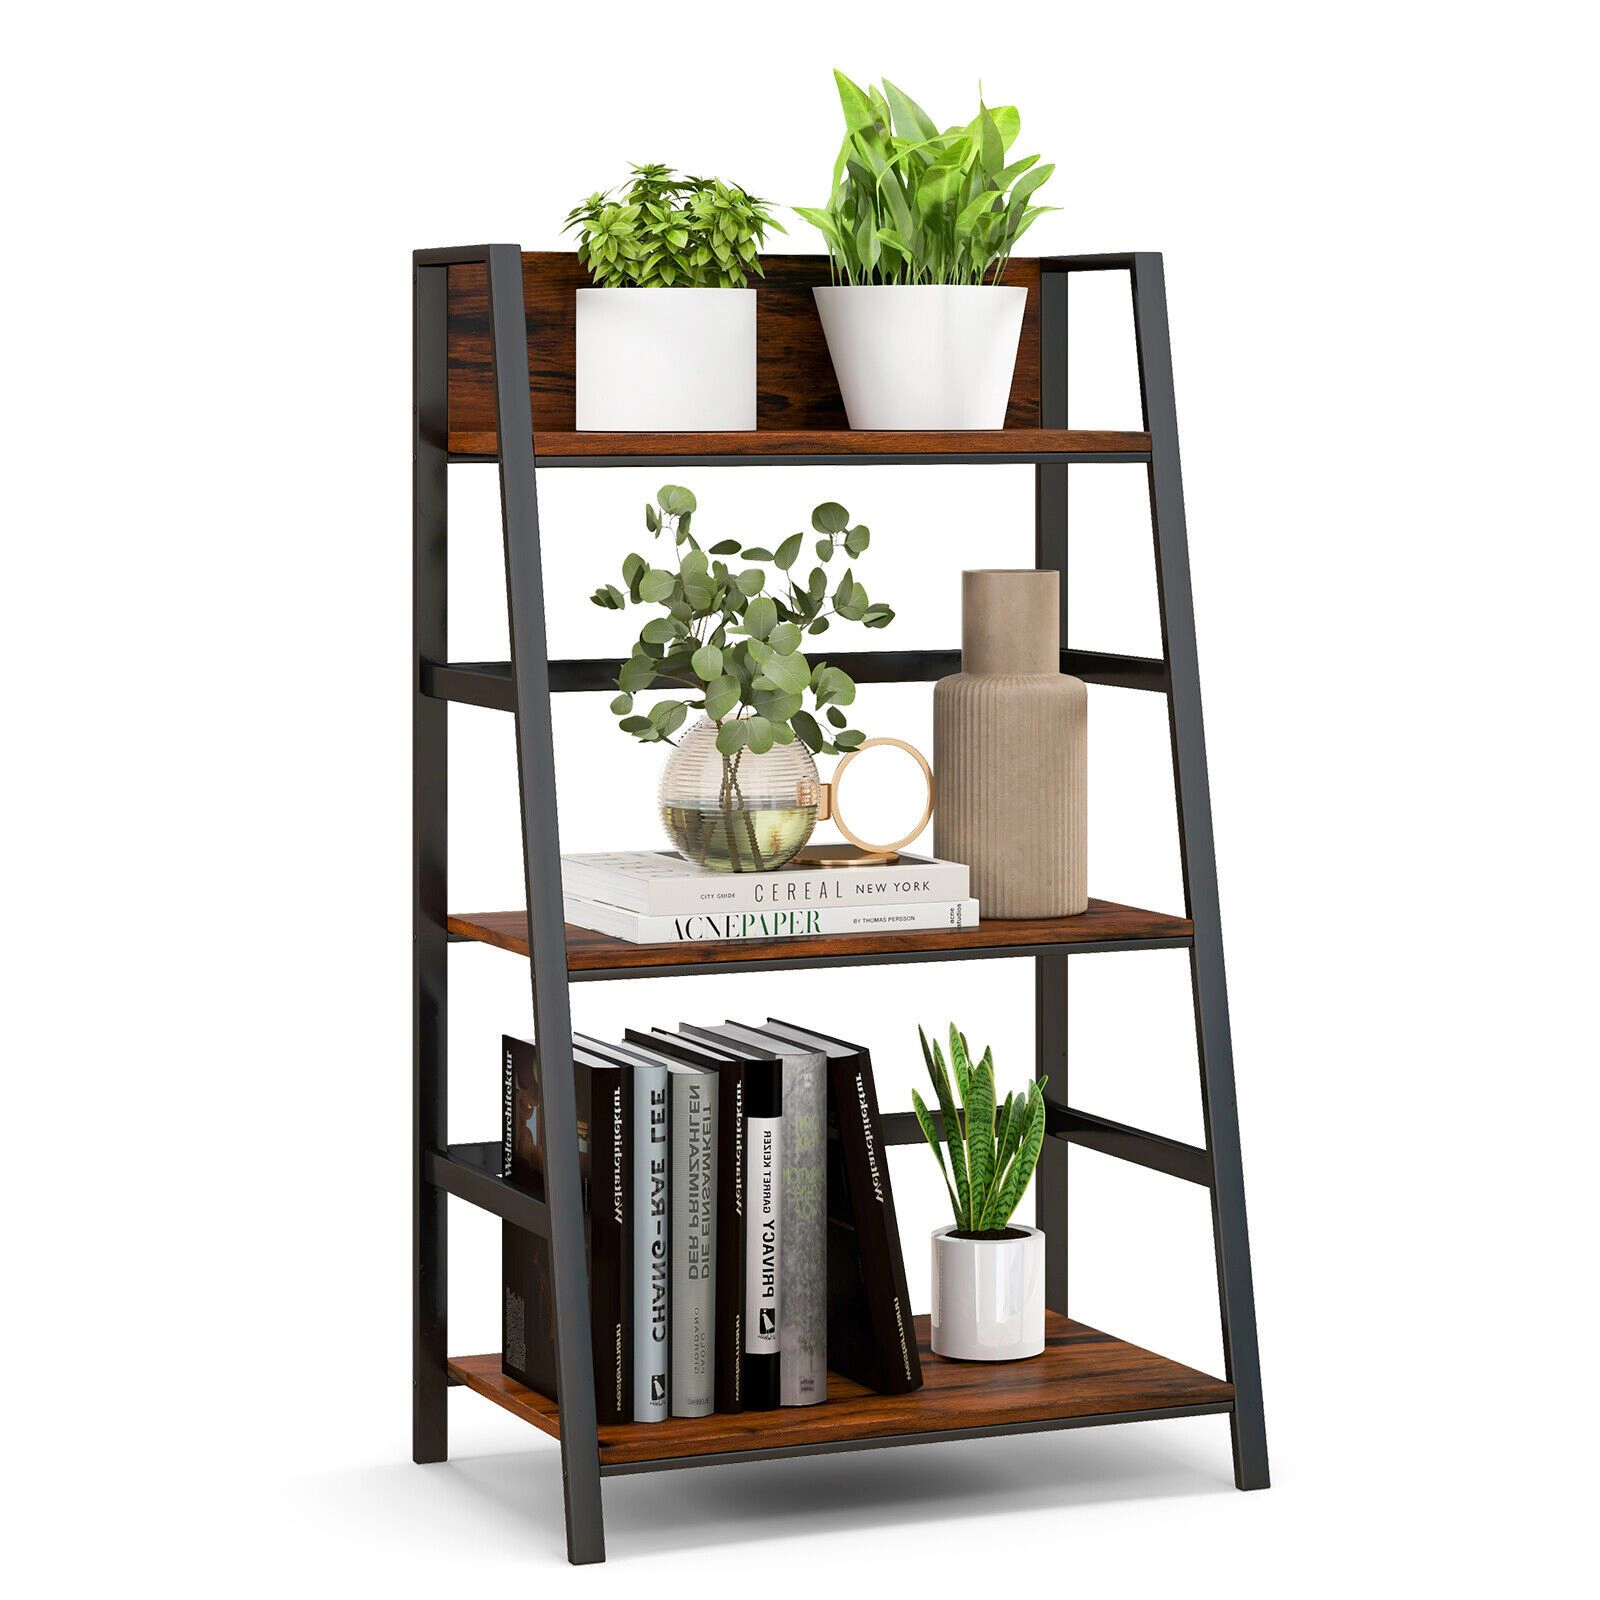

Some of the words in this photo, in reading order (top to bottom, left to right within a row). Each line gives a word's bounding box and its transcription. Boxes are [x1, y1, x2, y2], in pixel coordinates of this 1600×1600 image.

[754, 880, 843, 903] CEREAL
[855, 883, 887, 894] NEW
[893, 880, 930, 893] YORK
[862, 916, 887, 924] THOMAS
[504, 1050, 513, 1177] Weltarchitektur
